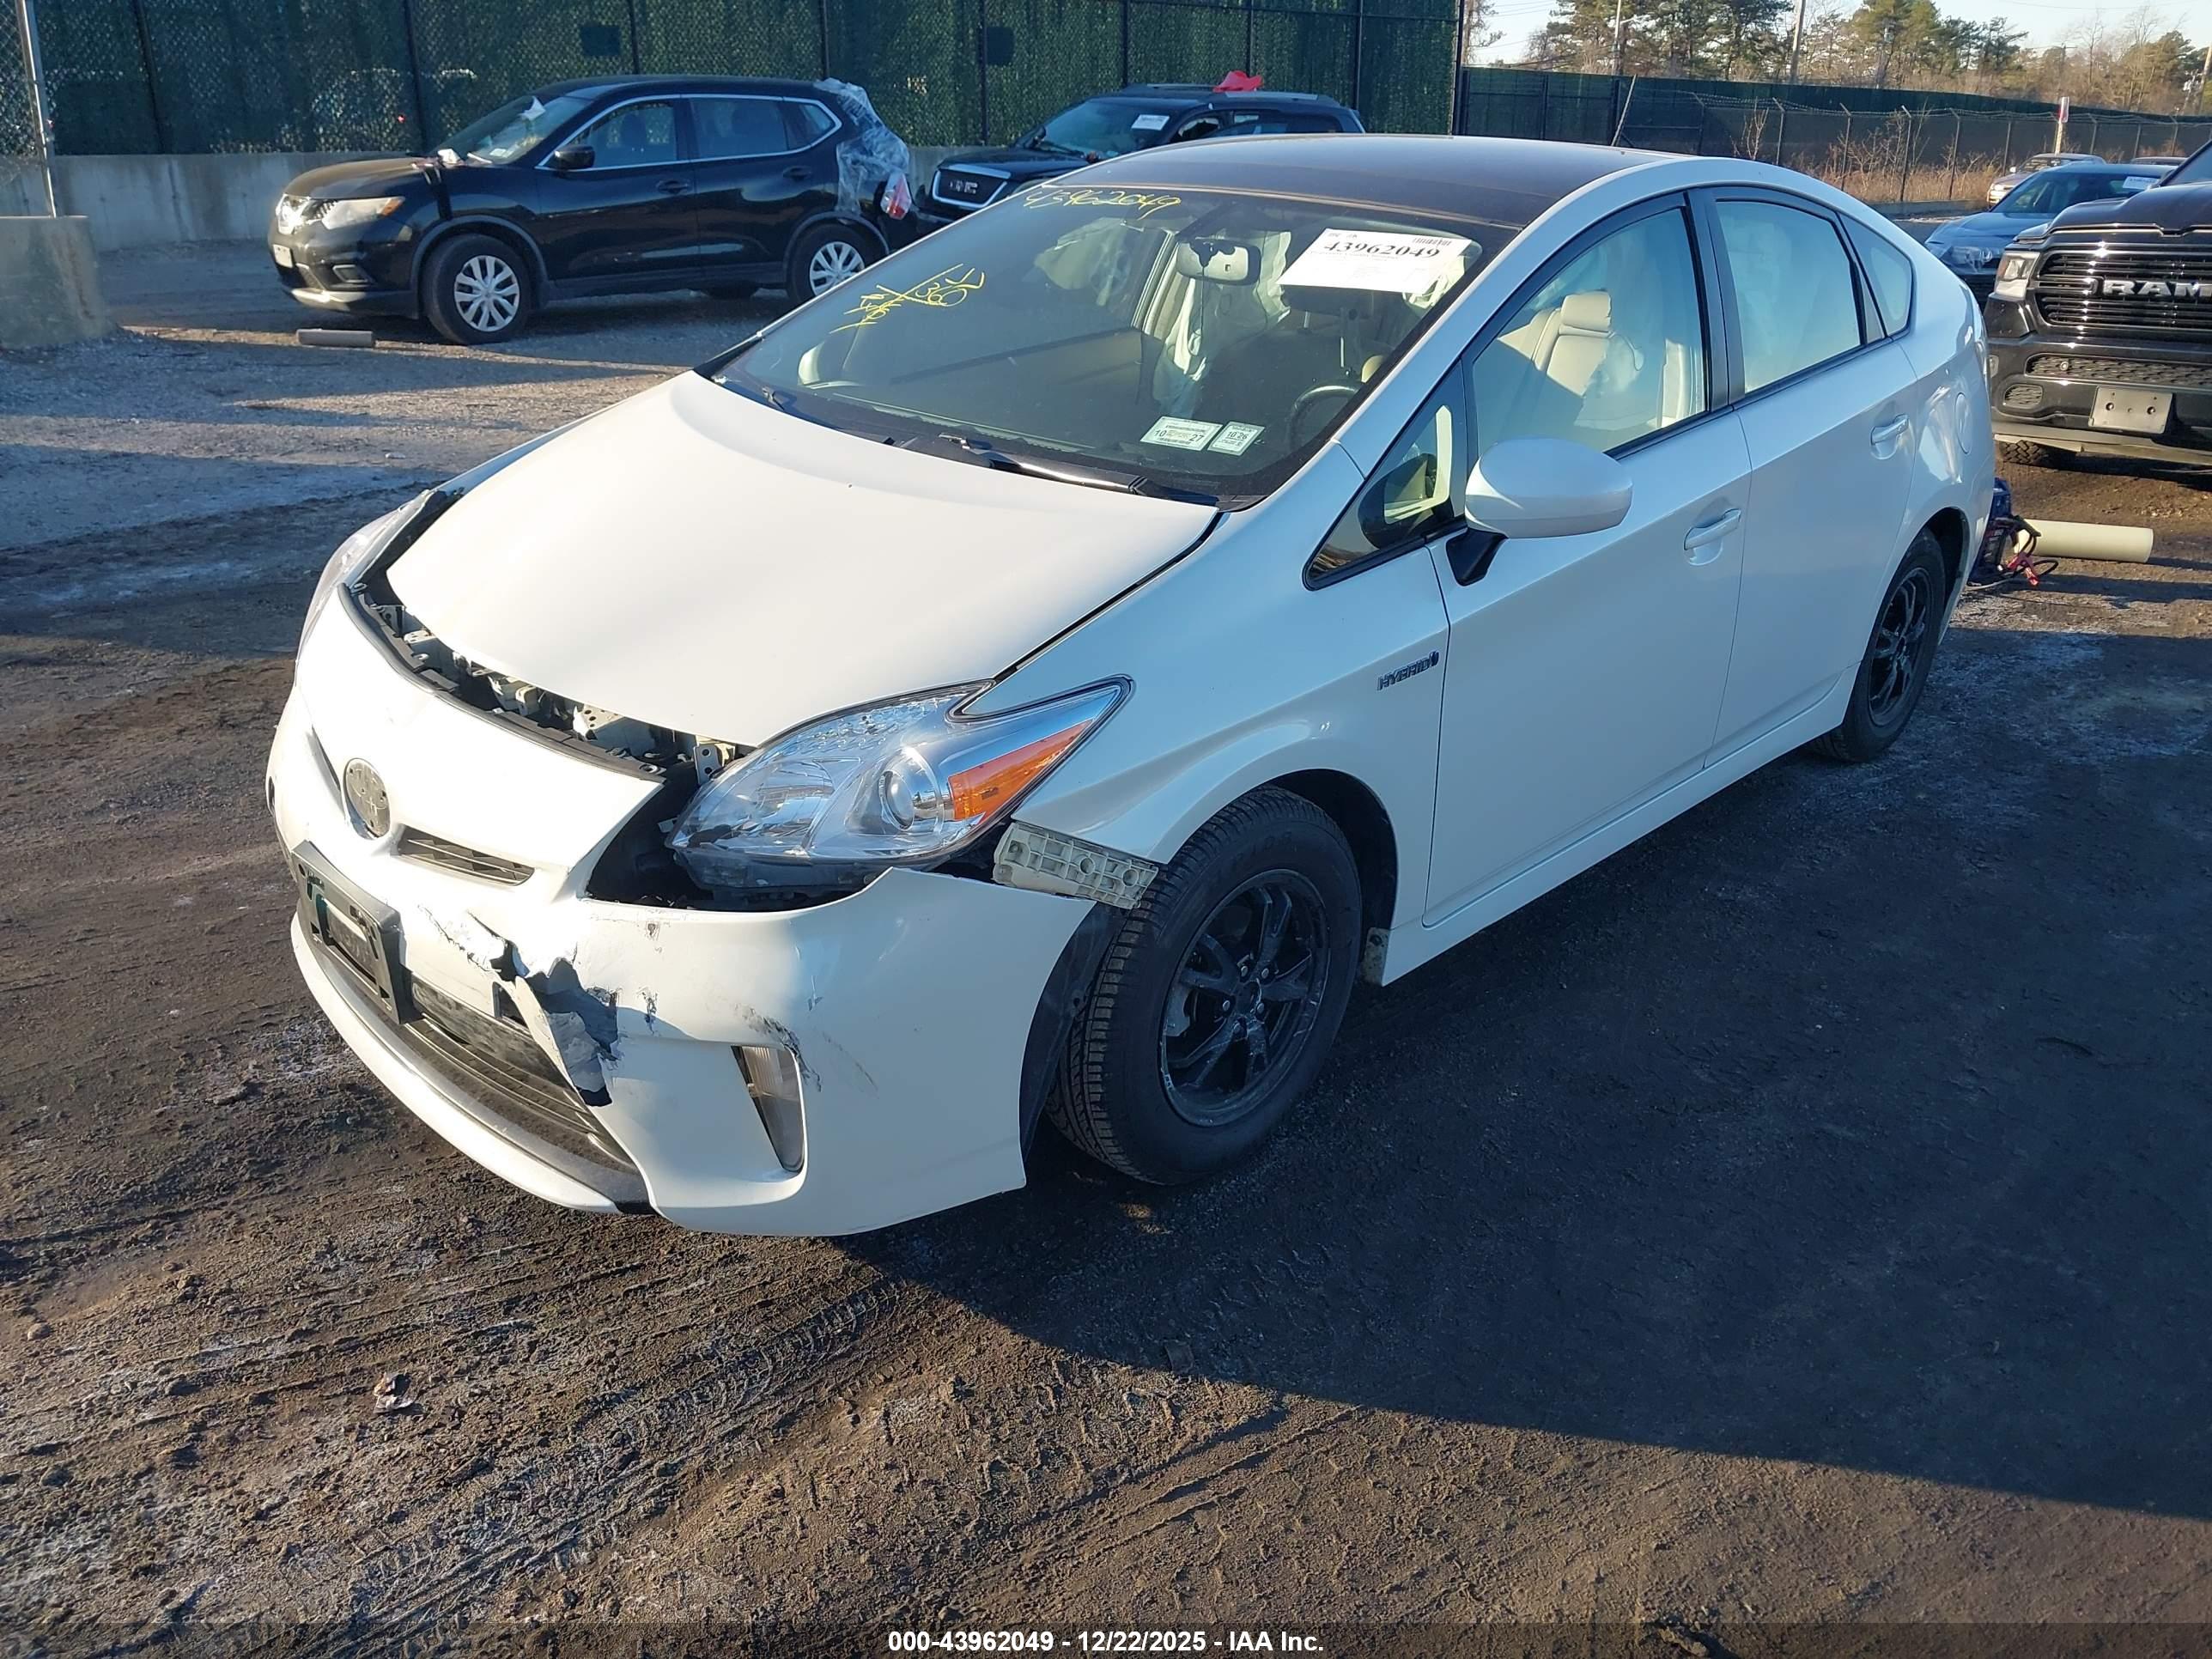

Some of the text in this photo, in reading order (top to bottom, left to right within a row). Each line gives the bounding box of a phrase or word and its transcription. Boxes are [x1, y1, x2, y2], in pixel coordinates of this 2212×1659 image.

[1323, 240, 1441, 258] 43962049
[2102, 279, 2212, 297] RAM
[1188, 434, 1205, 442] 27
